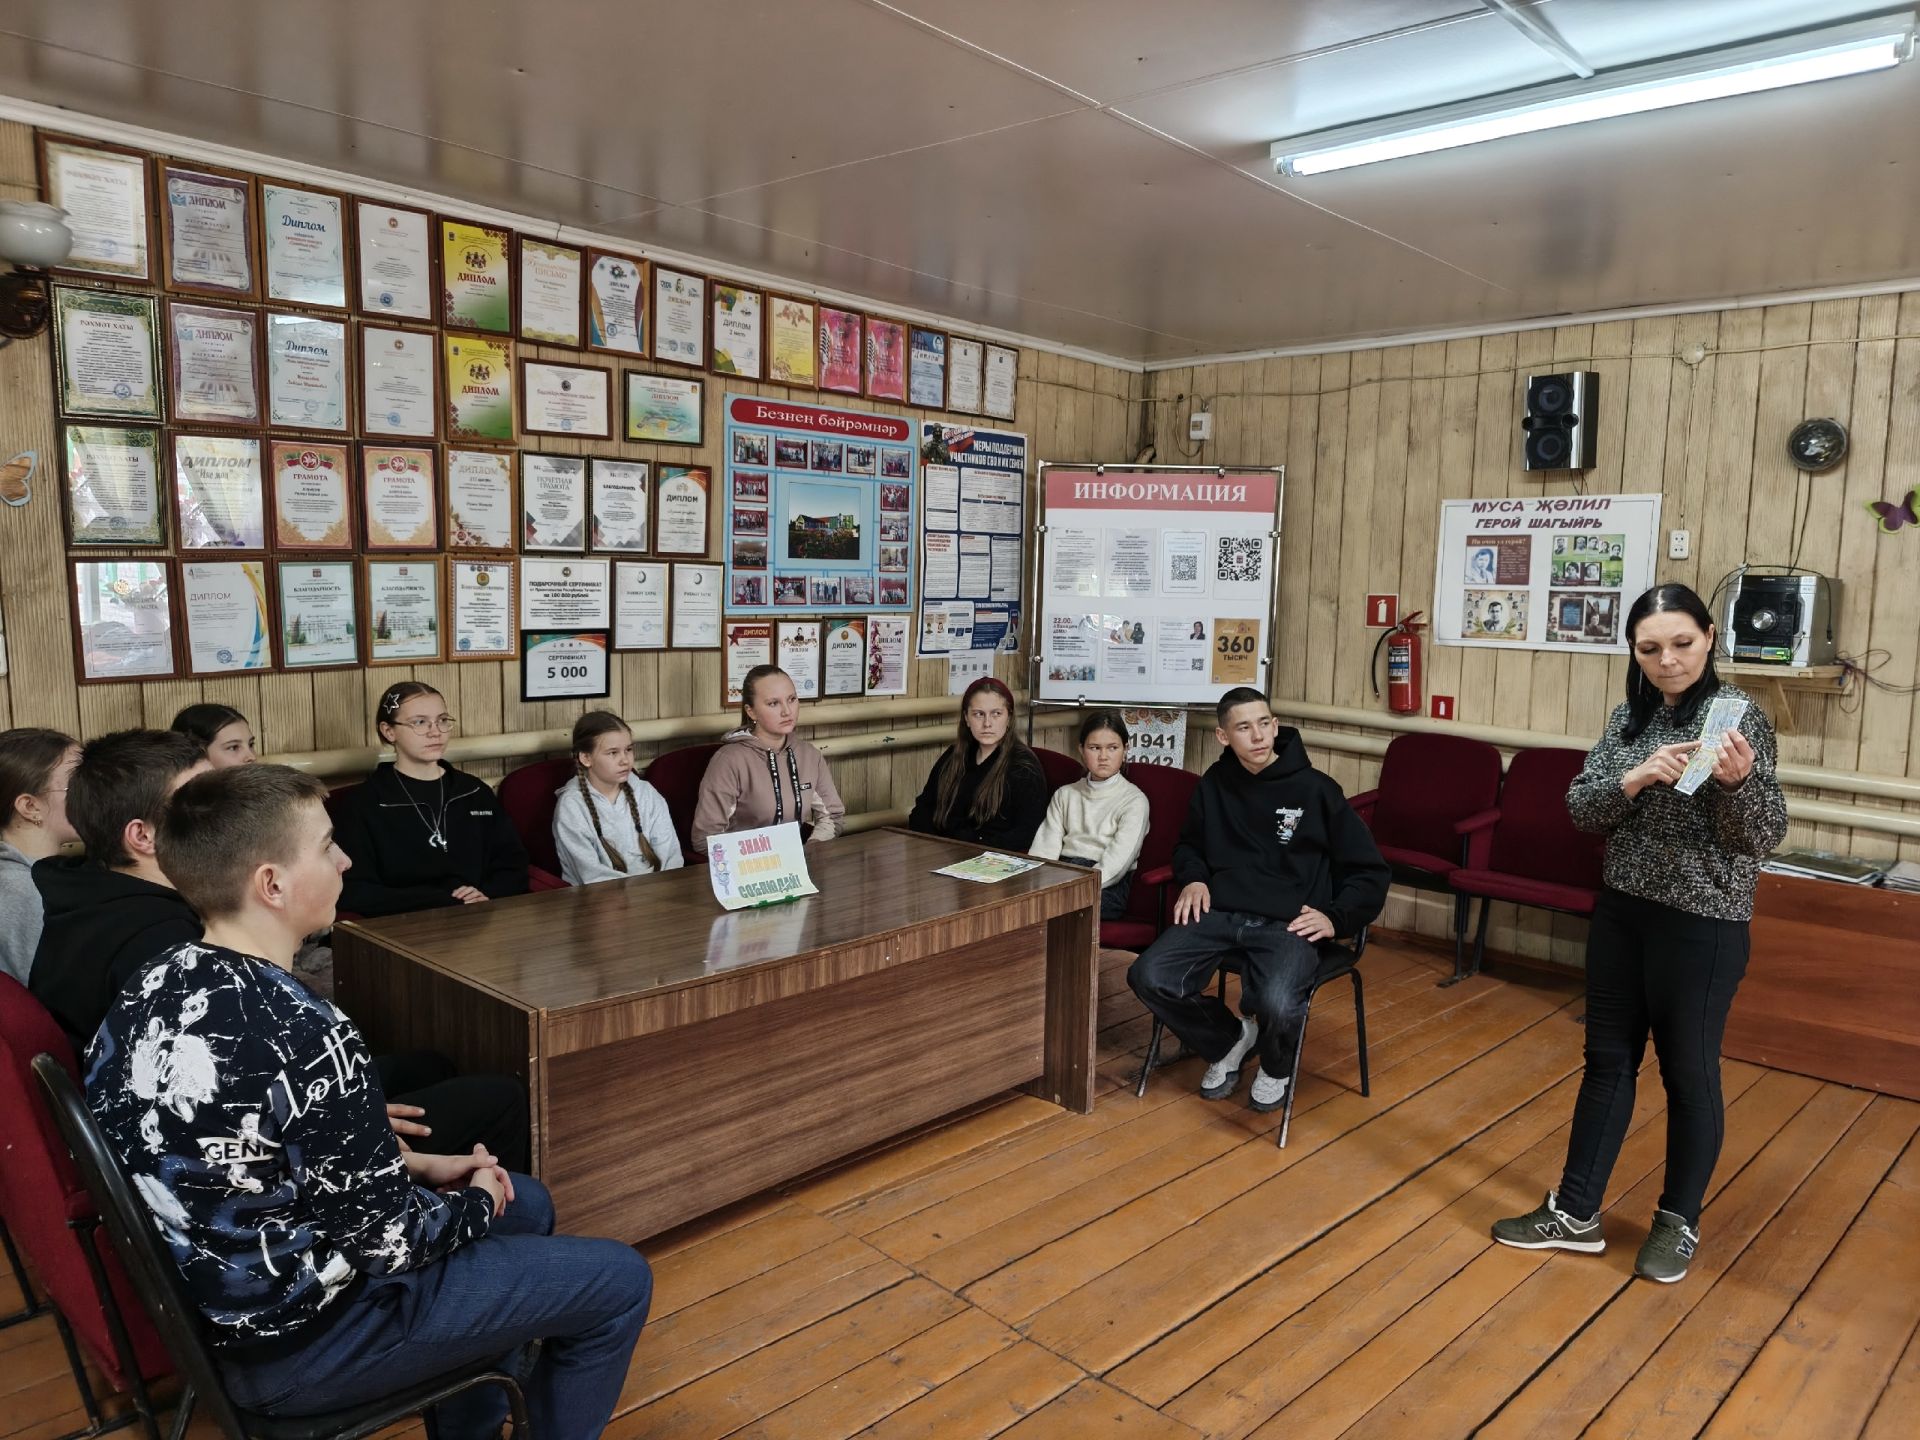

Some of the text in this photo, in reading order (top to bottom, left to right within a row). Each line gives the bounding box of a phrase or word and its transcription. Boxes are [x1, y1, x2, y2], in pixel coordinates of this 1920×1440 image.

[281, 214, 326, 232] Диплом
[457, 272, 497, 286] ДИПЛОМ
[722, 319, 752, 331] ДИПЛОМ
[286, 340, 328, 356] Диплом
[461, 385, 500, 396] ДИПЛОМ
[756, 405, 898, 437] Безнең бәйрәмнәр
[973, 440, 992, 452] МЕРЫ
[182, 456, 252, 468] ДИПЛОМ
[949, 450, 987, 466] УЧАСТНИКОВ
[293, 473, 329, 481] ГРАМОТА
[666, 494, 699, 503] ДИПЛОМ
[1073, 482, 1247, 504] ИНФОРМАЦИЯ
[1471, 498, 1612, 514] МУСА ҖӘЛИЛ
[1475, 516, 1603, 529] ГЕРОЙ ШАГЫЙРЬ
[189, 592, 232, 601] ДИПЛОМ
[1217, 635, 1255, 653] 360
[547, 665, 588, 678] 5 000
[1128, 732, 1176, 750] 1941
[737, 833, 772, 856] ЗНАЙ!
[737, 872, 802, 899] СОБЛЮДАЙ!
